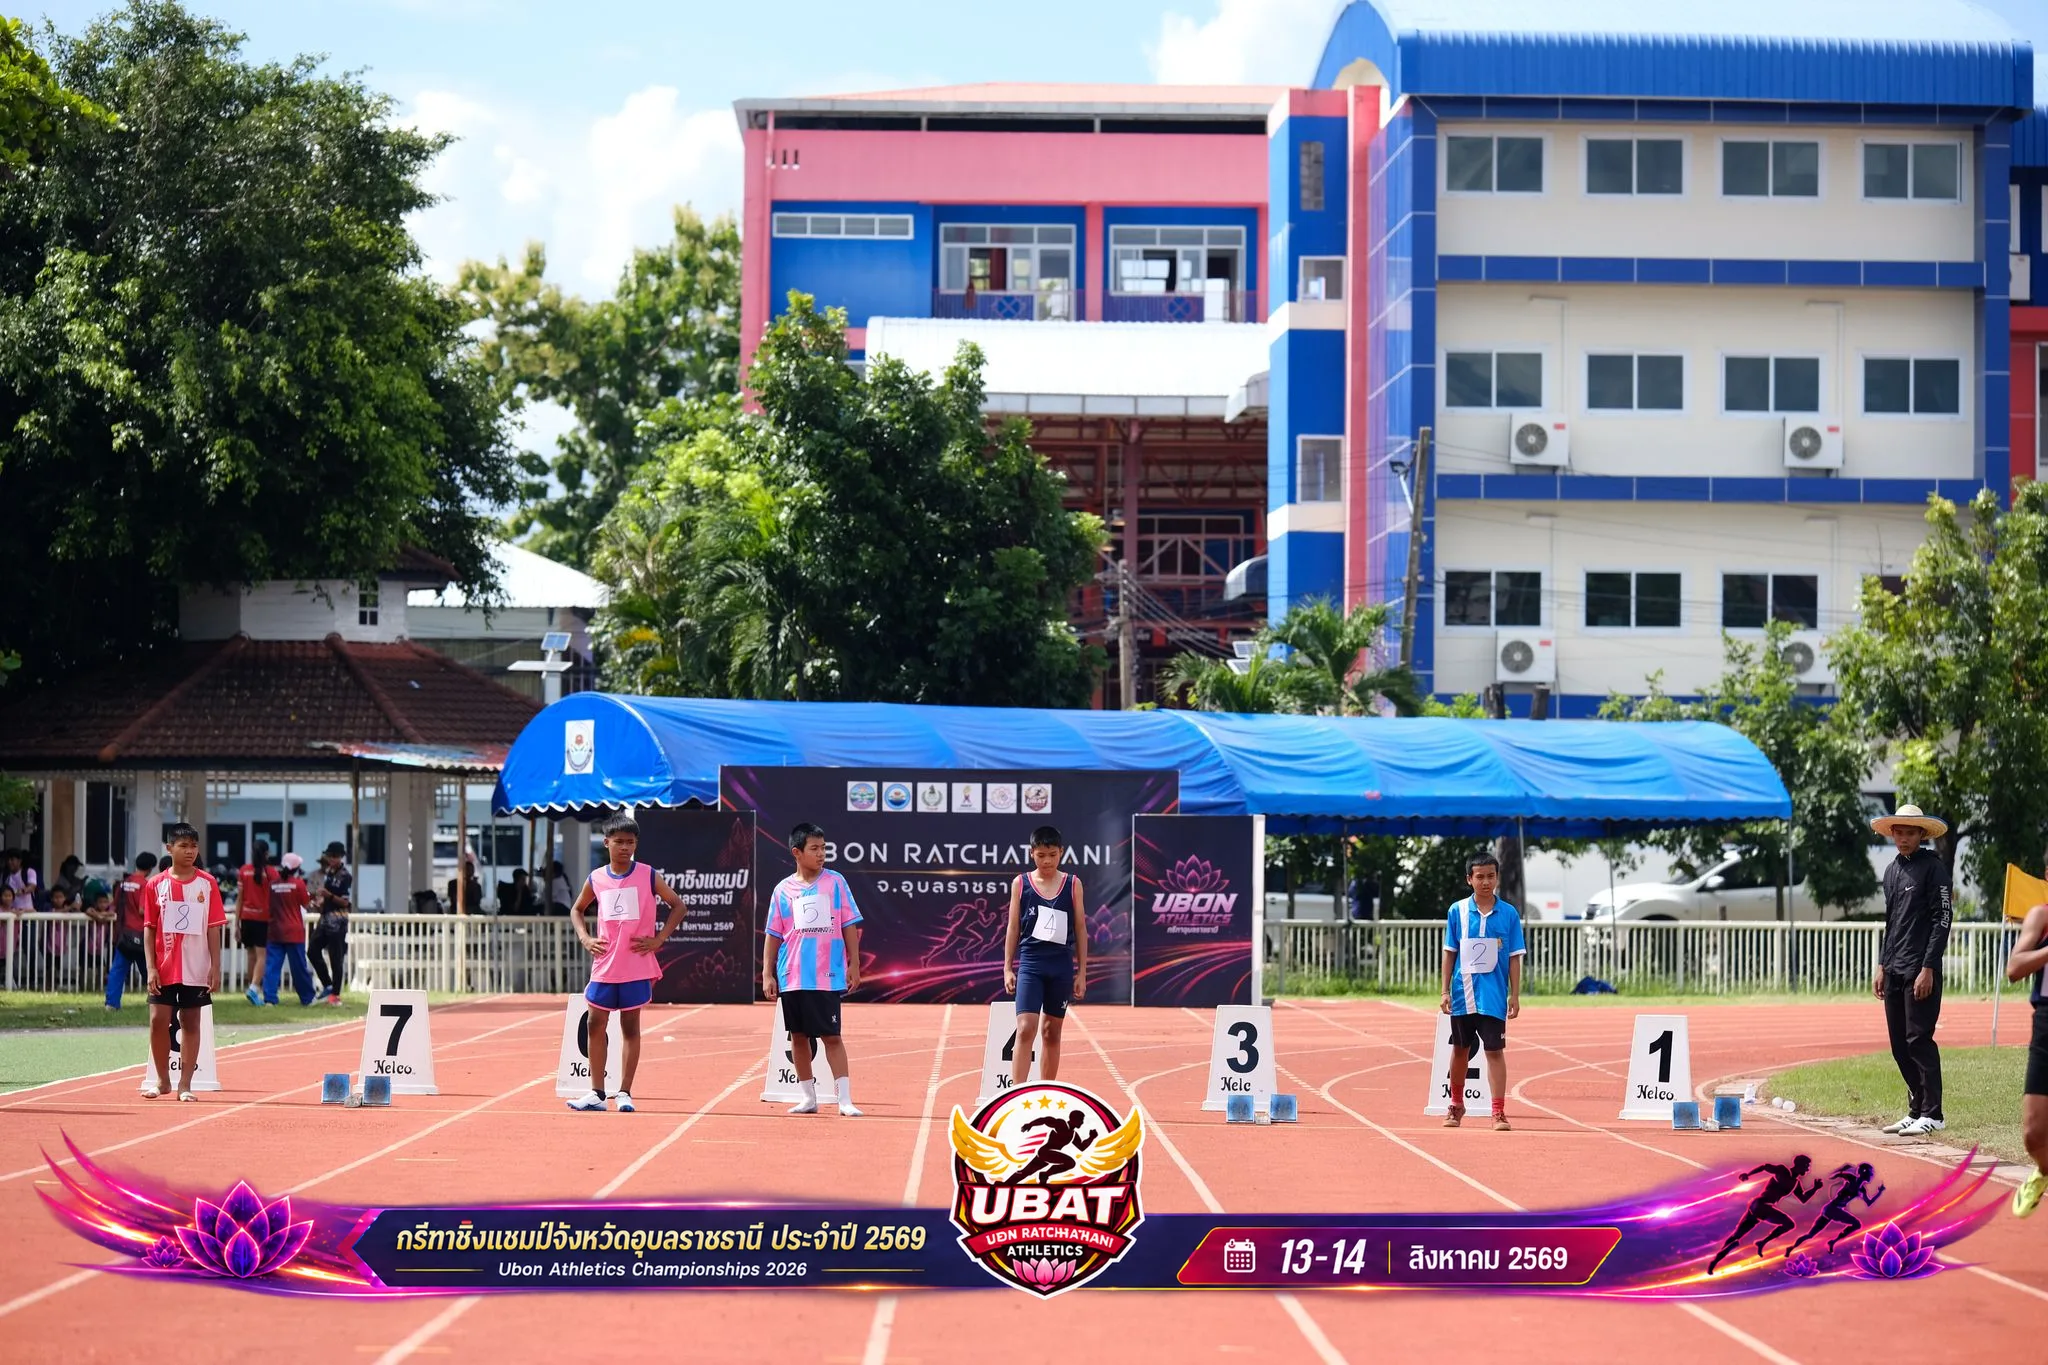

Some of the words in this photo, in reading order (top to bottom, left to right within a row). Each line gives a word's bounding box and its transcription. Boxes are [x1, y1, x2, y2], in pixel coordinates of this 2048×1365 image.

[824, 842, 888, 863] BON
[904, 843, 1111, 865] RATCHATANI
[613, 893, 624, 914] 6
[1151, 892, 1239, 913] UBON
[1940, 885, 1951, 910] NIKE
[174, 904, 190, 931] 8
[802, 901, 819, 924] 5
[1043, 912, 1057, 936] 4
[1152, 913, 1234, 926] ATHLETICS
[1940, 909, 1951, 929] PRO
[713, 921, 735, 931] 2569
[1470, 942, 1487, 967] 2
[380, 1004, 413, 1056] 7
[1226, 1021, 1260, 1074] 3
[1648, 1030, 1674, 1083] 1
[374, 1059, 413, 1075] Nelco
[1637, 1084, 1674, 1101] Nelco
